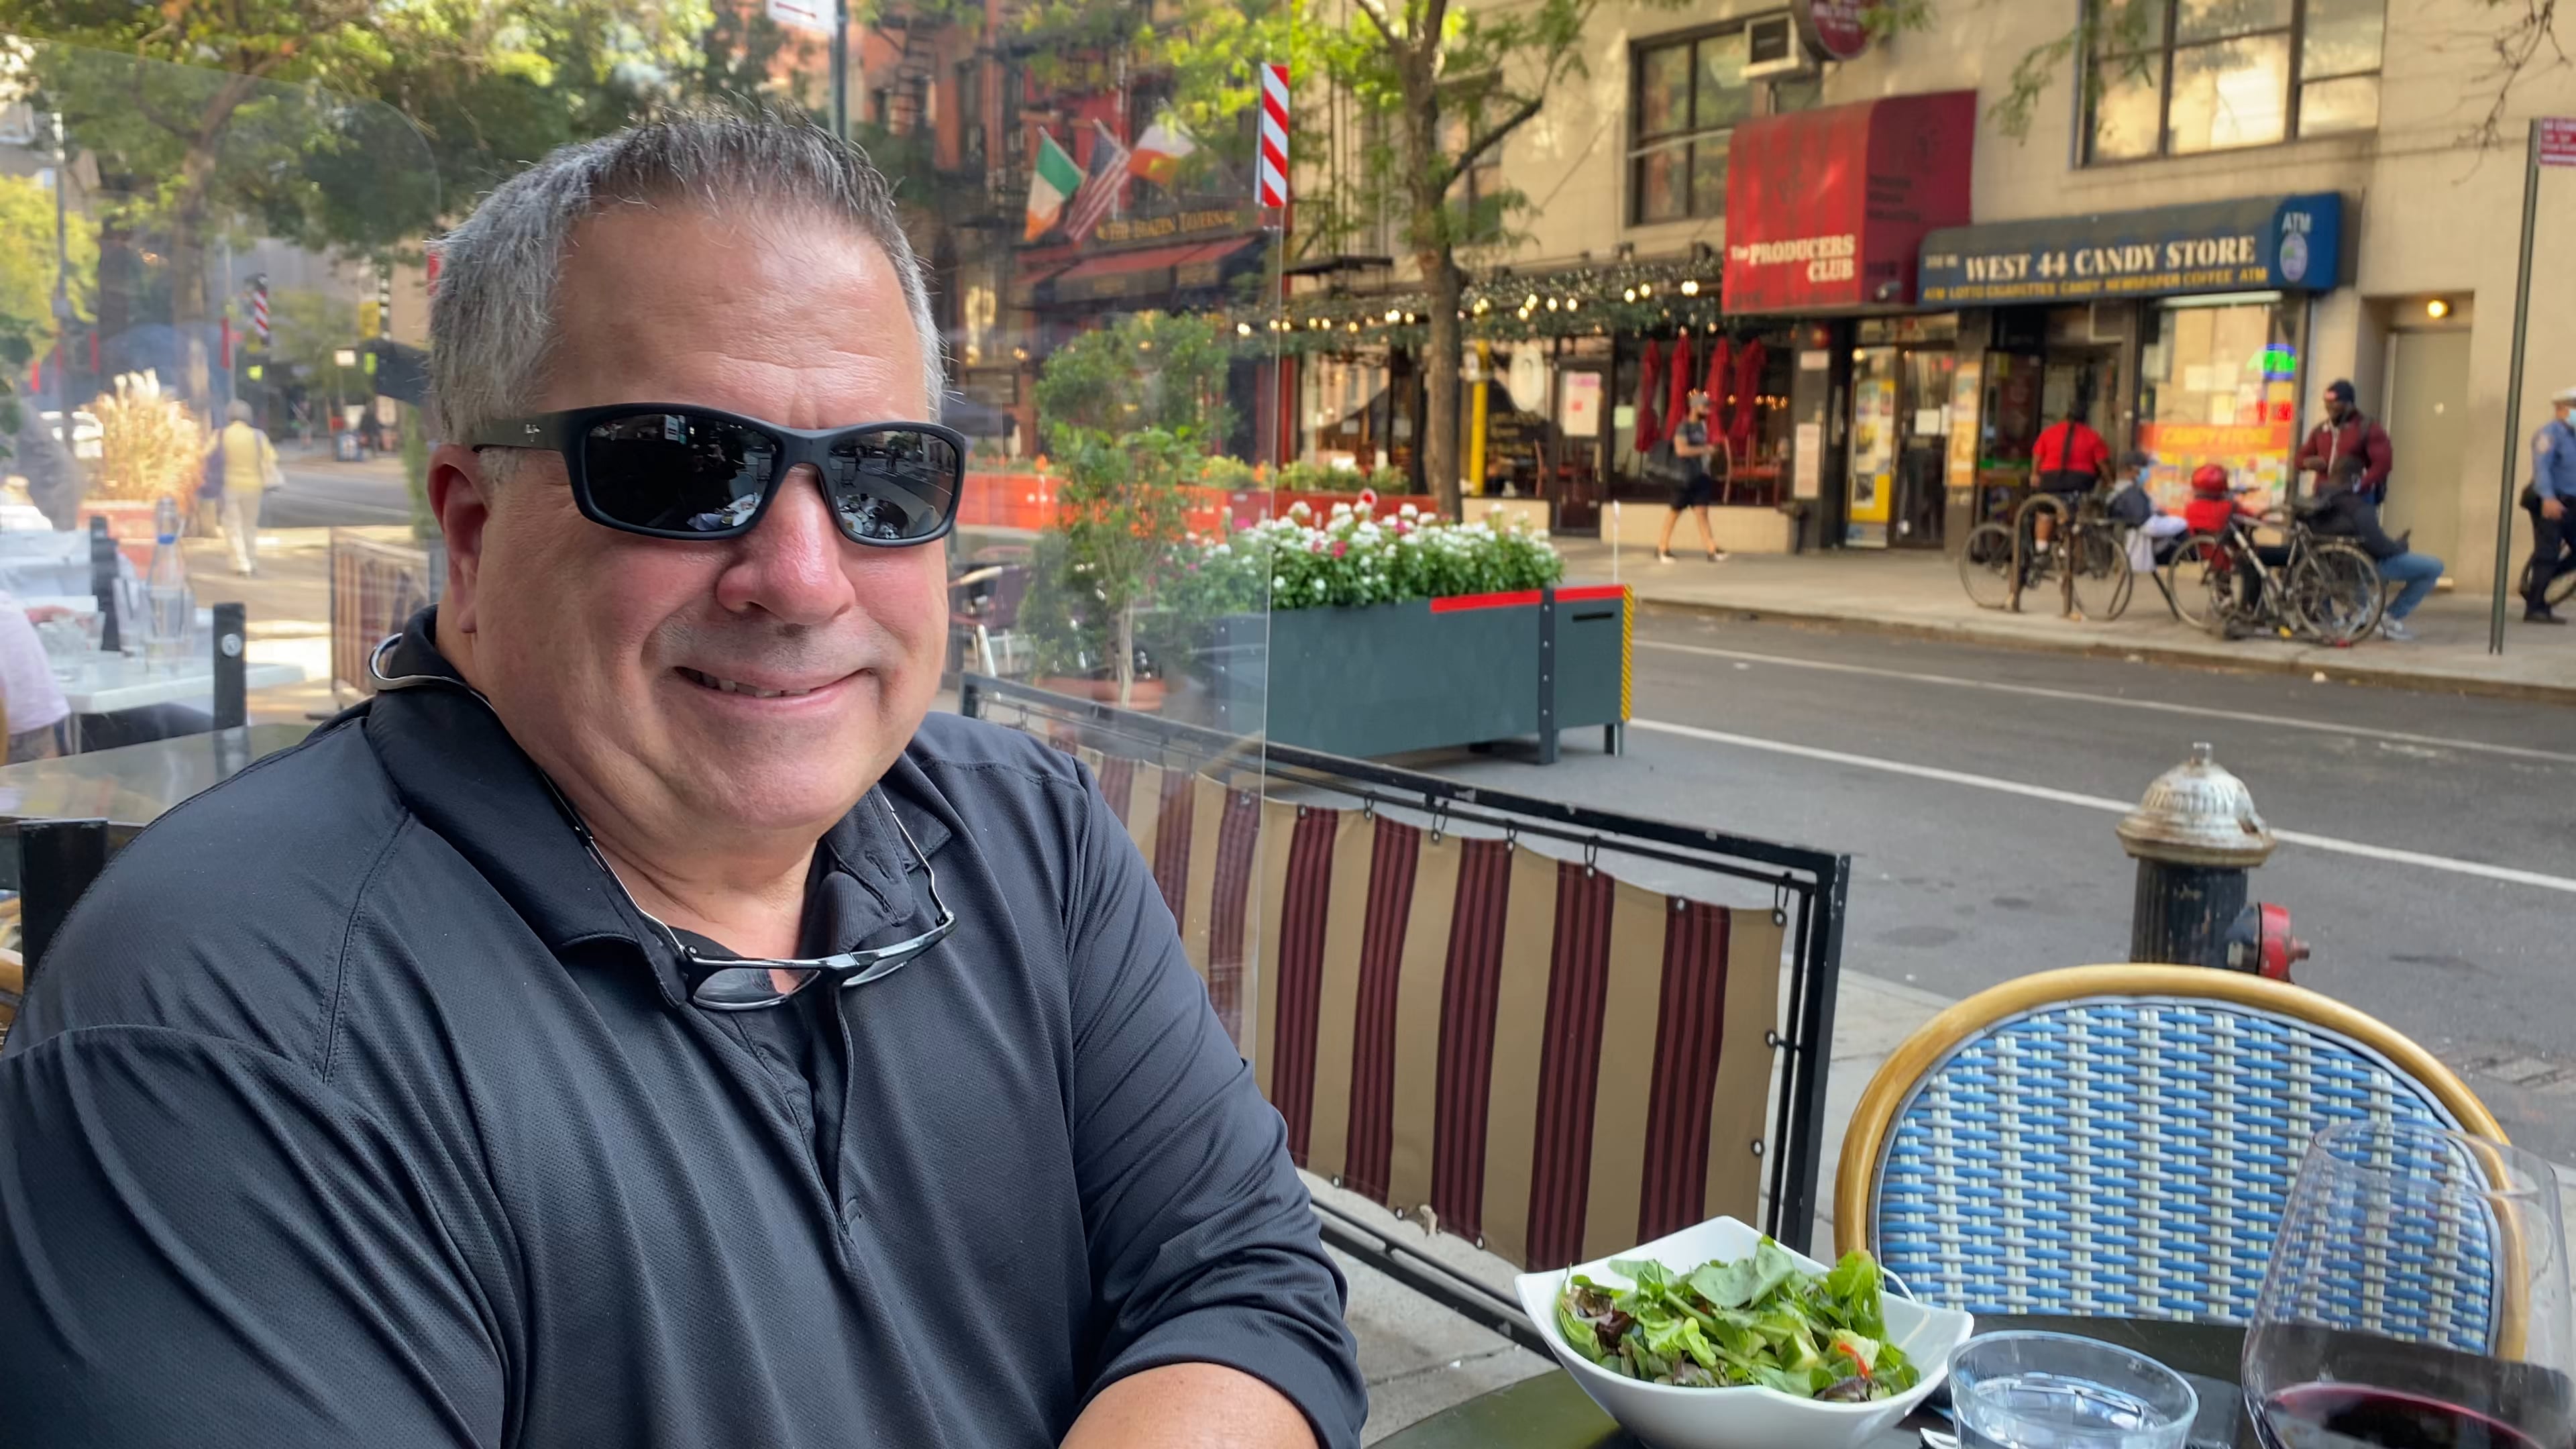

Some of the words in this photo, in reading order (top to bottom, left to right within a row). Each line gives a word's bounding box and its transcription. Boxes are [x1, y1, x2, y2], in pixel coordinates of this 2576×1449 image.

[2282, 211, 2312, 234] ATM
[1749, 233, 1856, 266] PRODUCERS
[1966, 252, 2032, 282] WEST
[2036, 250, 2068, 278] 44
[2074, 242, 2161, 276] CANDY
[2165, 235, 2256, 269] STORE
[1807, 257, 1854, 283] CLUB
[2239, 265, 2268, 282] ATM
